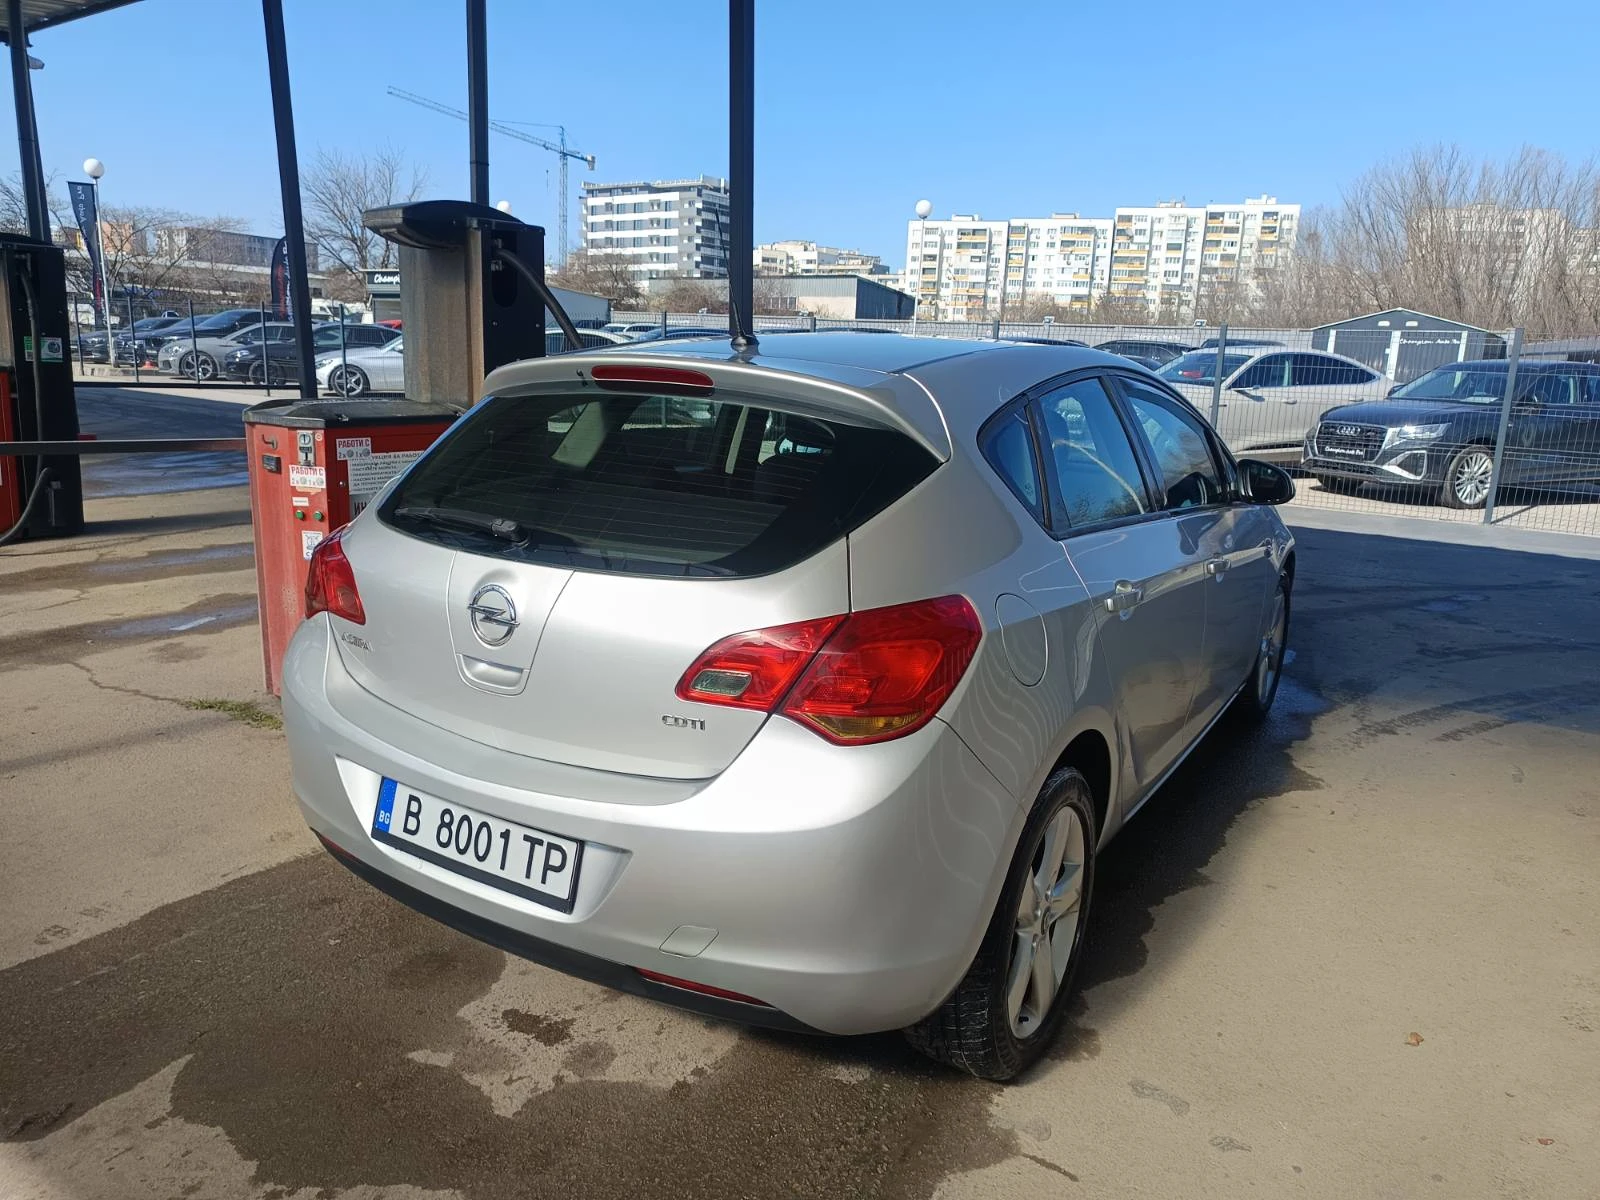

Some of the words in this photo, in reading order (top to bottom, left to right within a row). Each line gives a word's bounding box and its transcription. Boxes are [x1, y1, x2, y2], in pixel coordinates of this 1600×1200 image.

[338, 439, 363, 448] РАБОТИ
[291, 466, 318, 476] РАБОТИ
[378, 810, 391, 825] BG
[402, 794, 422, 836] B
[436, 808, 511, 871] 8001
[522, 834, 568, 885] TP
